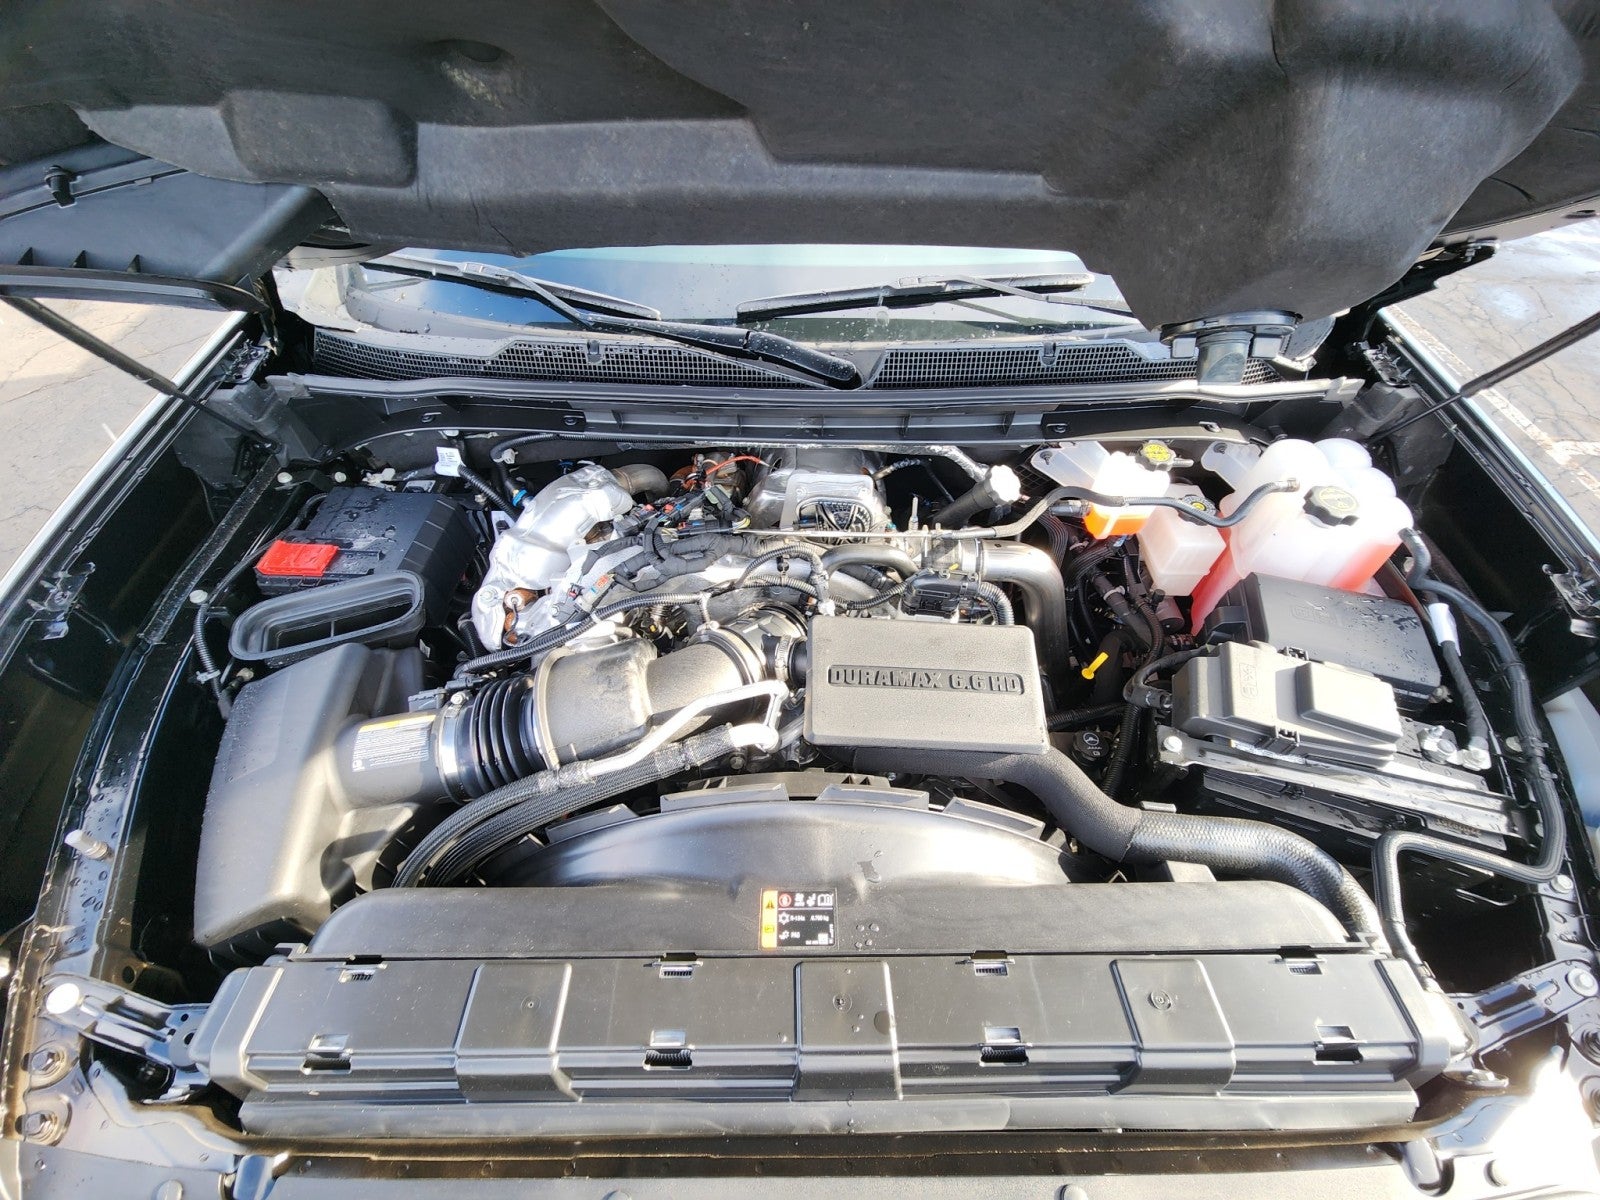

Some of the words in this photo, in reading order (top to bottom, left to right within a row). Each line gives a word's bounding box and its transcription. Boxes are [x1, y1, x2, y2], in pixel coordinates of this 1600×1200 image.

[831, 667, 943, 689] DURAMAX
[949, 673, 989, 691] 6.6
[990, 674, 1022, 693] HD
